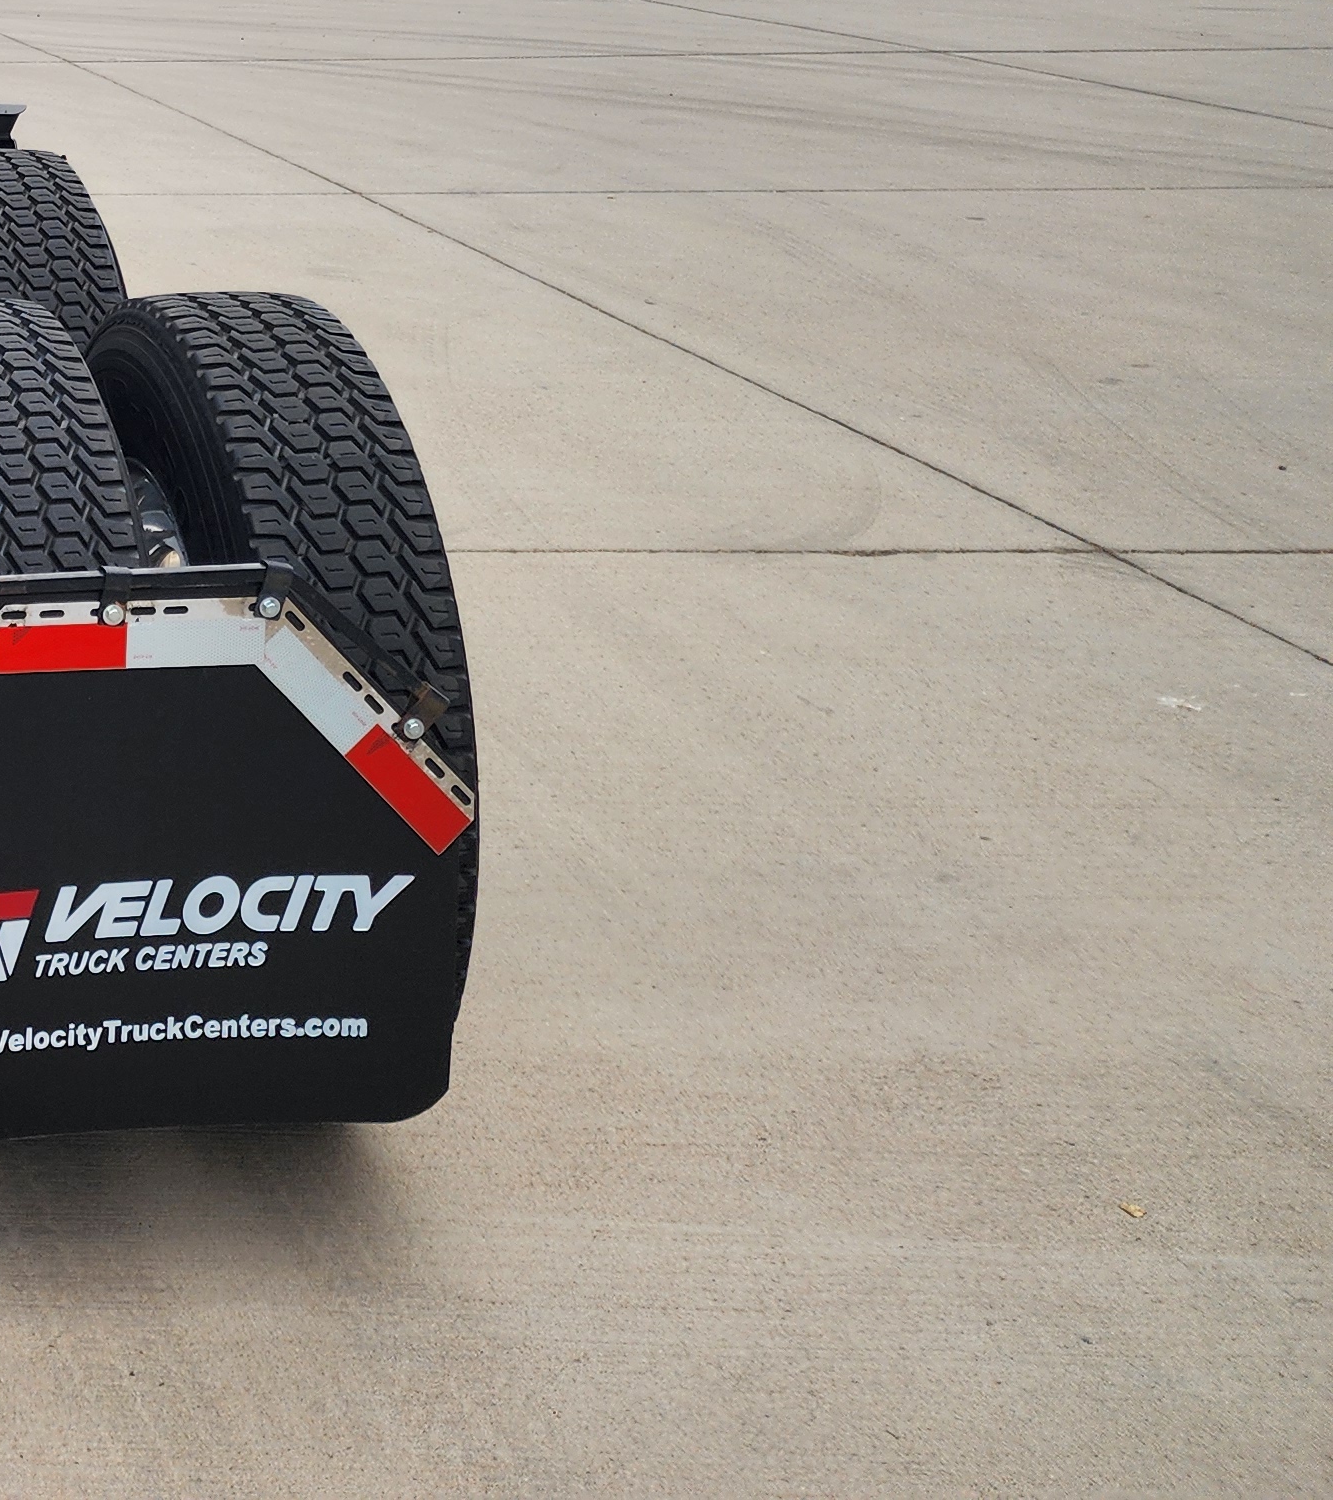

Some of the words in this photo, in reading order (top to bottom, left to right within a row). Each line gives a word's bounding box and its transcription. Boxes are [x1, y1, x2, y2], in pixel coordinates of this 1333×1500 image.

[44, 874, 416, 943] VELOCITY
[35, 948, 129, 978] TRUCK
[135, 941, 269, 971] CENTERS
